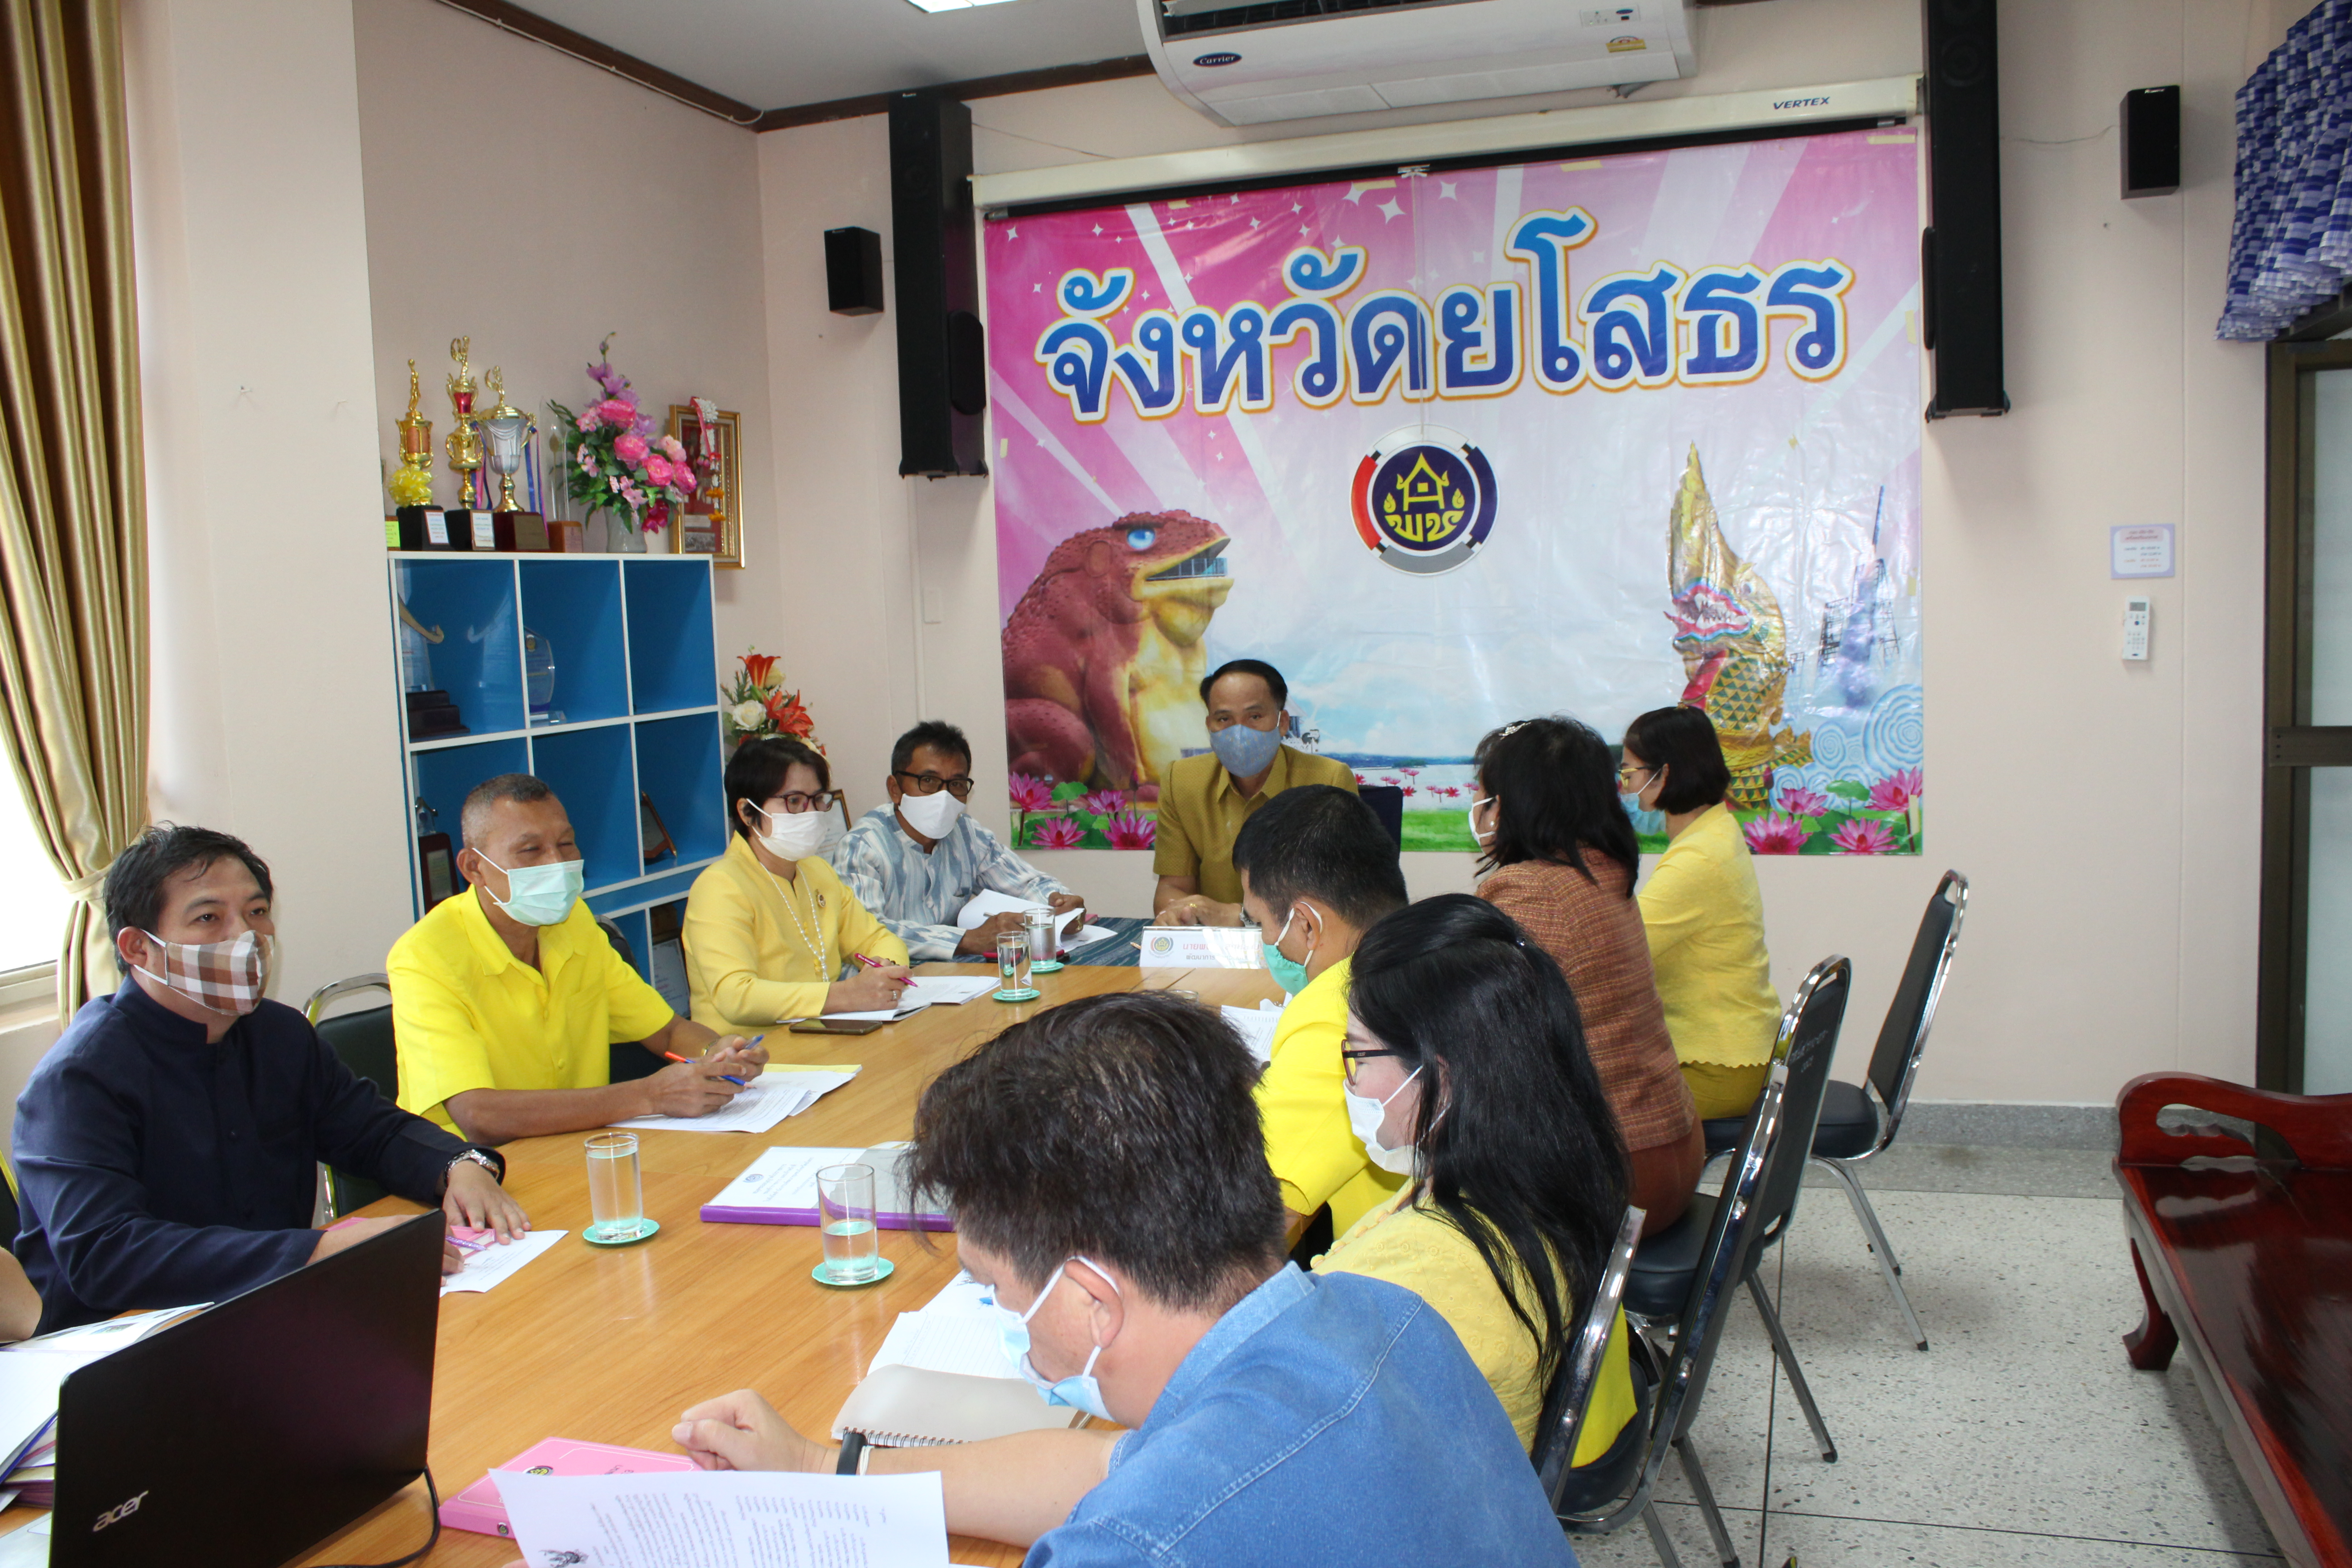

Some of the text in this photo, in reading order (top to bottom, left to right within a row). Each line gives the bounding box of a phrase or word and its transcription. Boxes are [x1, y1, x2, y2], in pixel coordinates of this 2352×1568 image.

[1199, 55, 1236, 65] Carrier
[1773, 96, 1830, 110] VERTEX
[1038, 210, 1848, 417] จังหวัดยโสธร
[93, 1490, 149, 1532] acer
